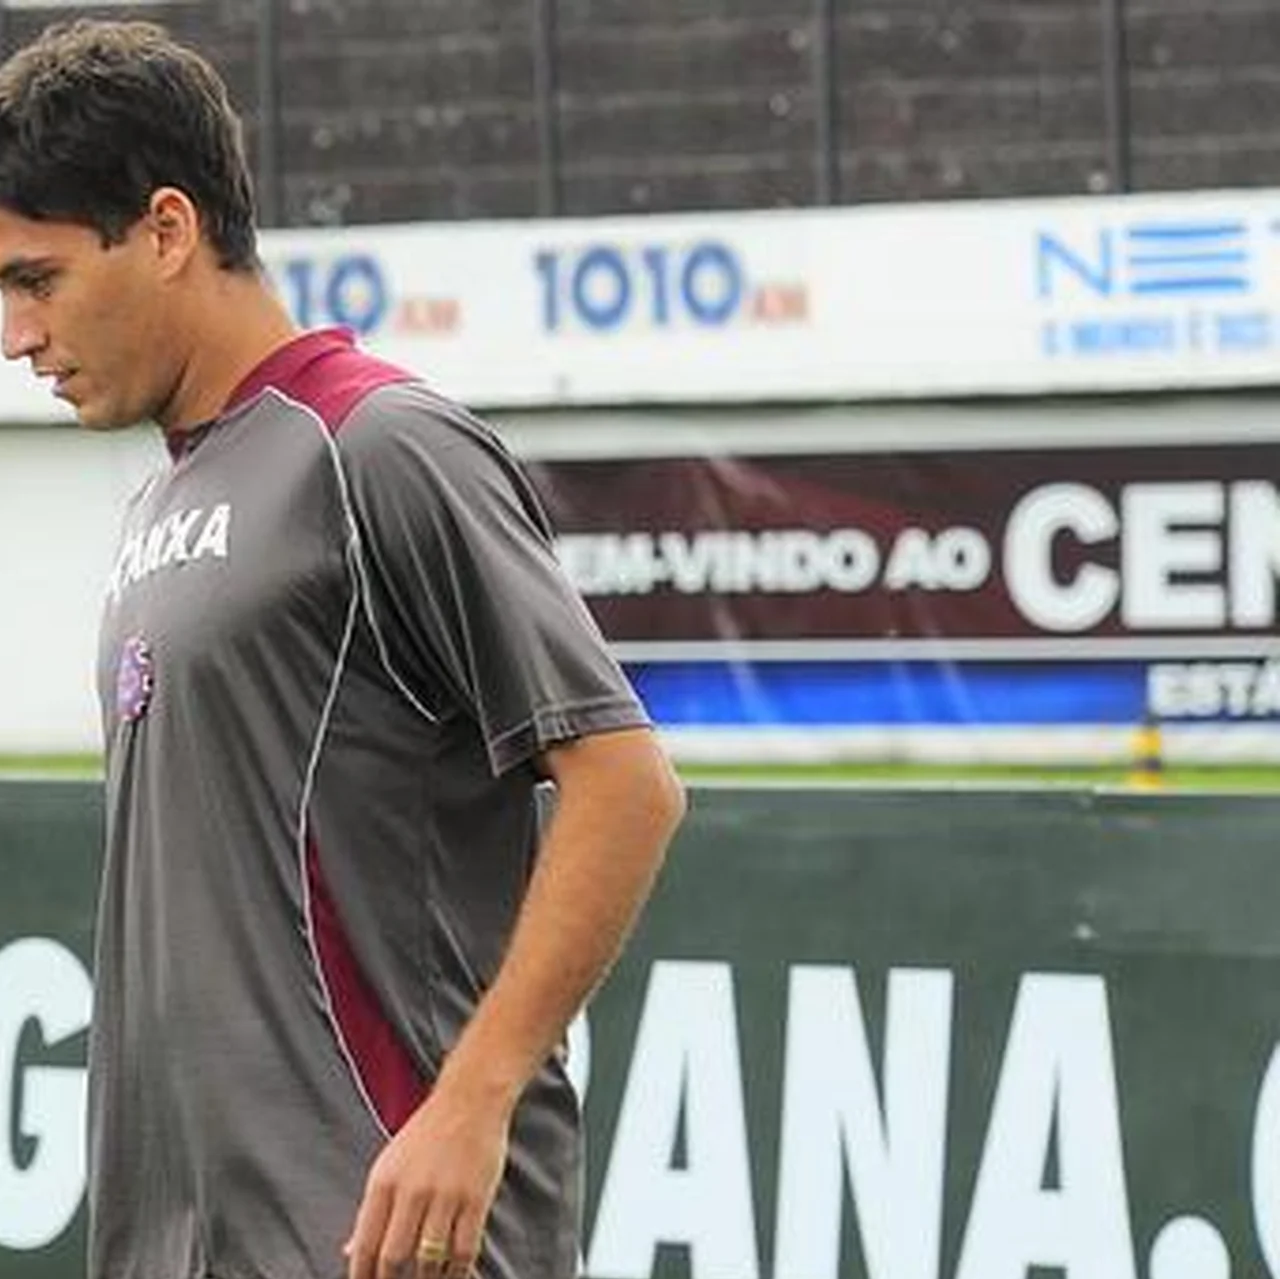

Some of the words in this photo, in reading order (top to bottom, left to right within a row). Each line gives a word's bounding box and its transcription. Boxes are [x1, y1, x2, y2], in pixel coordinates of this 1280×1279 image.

[534, 241, 744, 333] 1010
[1036, 222, 1280, 298] NE
[552, 527, 880, 594] EM-VINDO
[884, 526, 991, 592] AO
